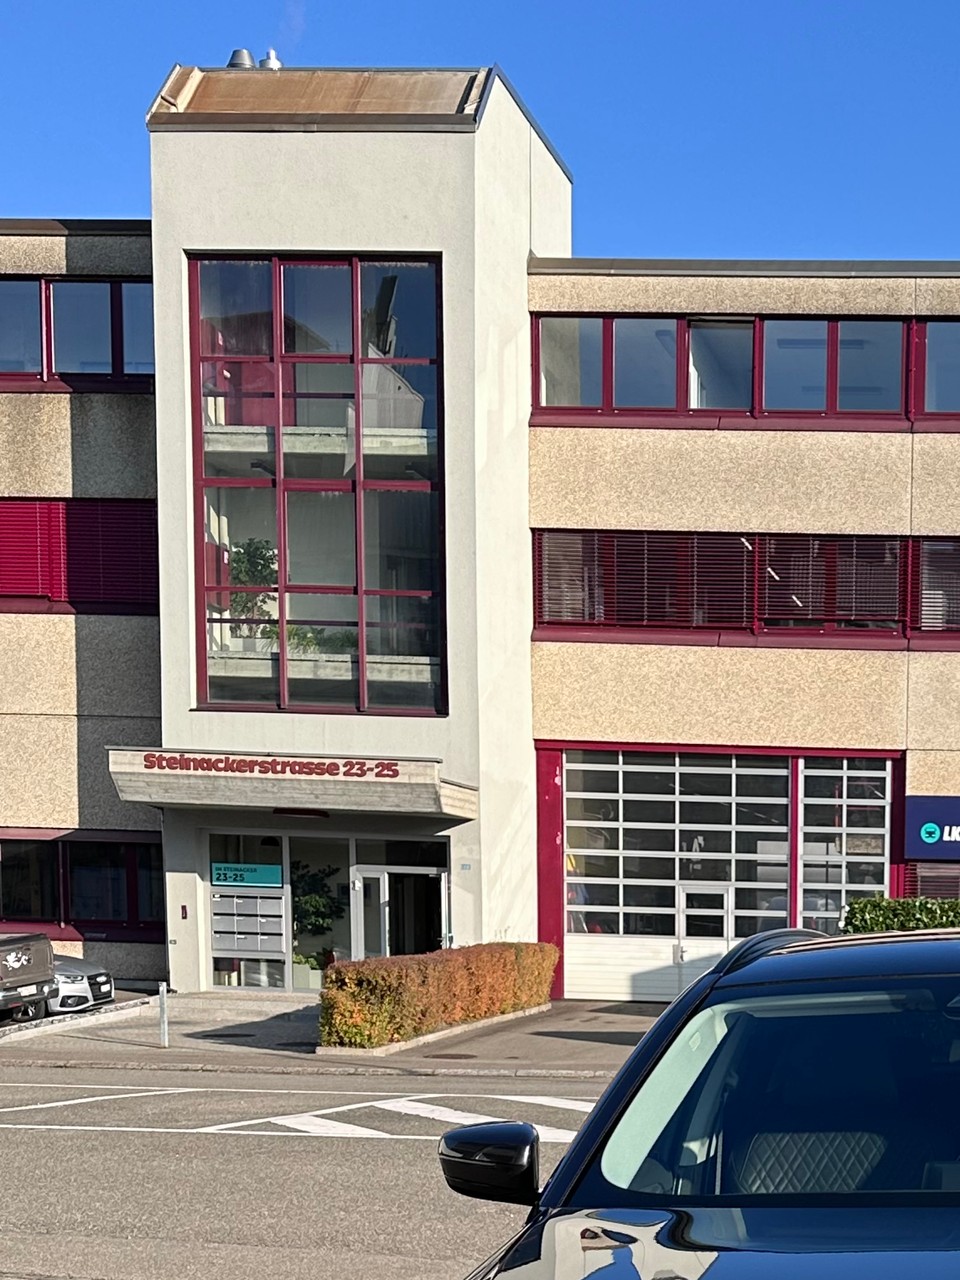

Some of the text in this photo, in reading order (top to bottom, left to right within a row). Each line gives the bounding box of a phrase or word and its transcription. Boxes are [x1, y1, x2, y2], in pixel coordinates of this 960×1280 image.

[143, 752, 400, 778] Steinackerstrasse 23-25
[215, 872, 245, 882] 23-25
